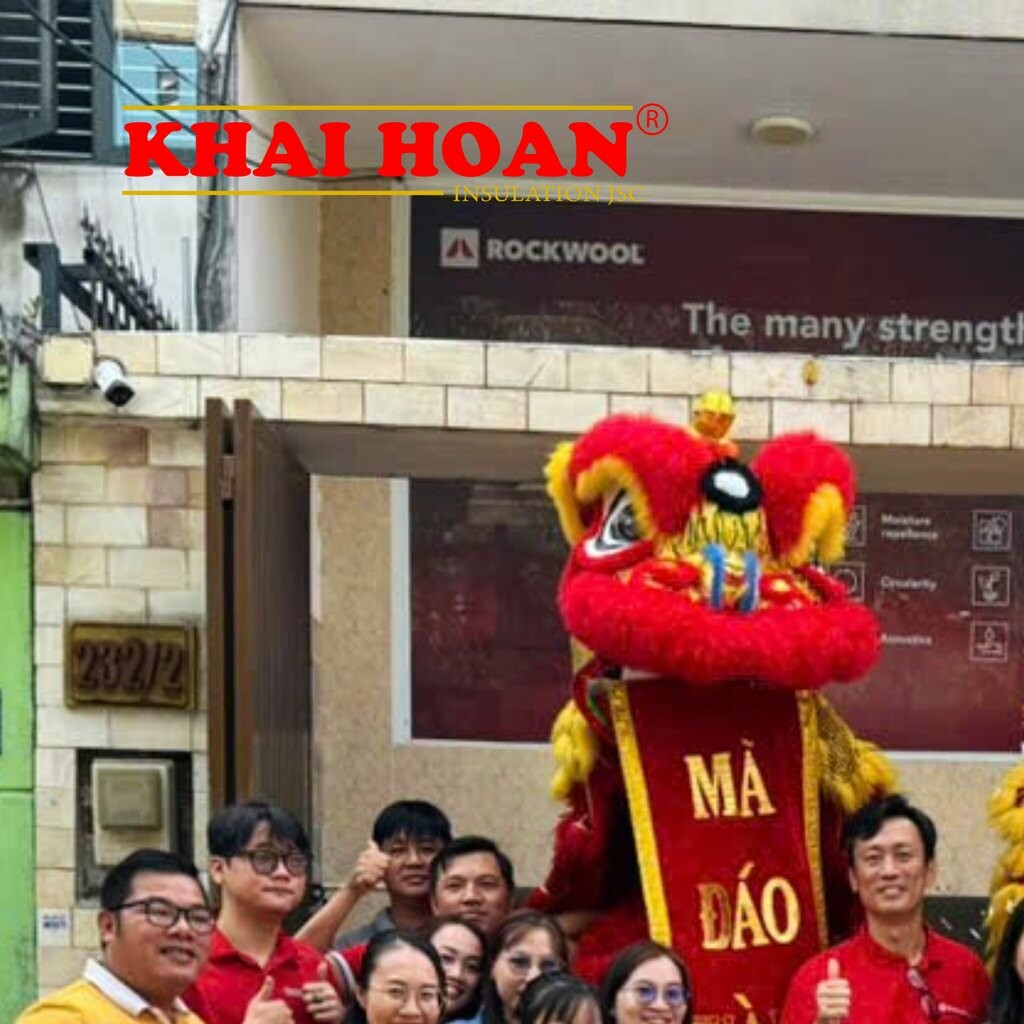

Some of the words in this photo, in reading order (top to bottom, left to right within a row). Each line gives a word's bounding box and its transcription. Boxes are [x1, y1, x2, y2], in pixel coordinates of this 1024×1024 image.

[486, 238, 645, 265] ROCKWOOL
[683, 302, 751, 336] The
[764, 312, 866, 349] many
[881, 513, 931, 526] Moisture
[880, 576, 937, 592] Circularity
[76, 639, 183, 693] 232/2
[684, 738, 776, 819] MÀ
[697, 861, 801, 950] ĐÁO
